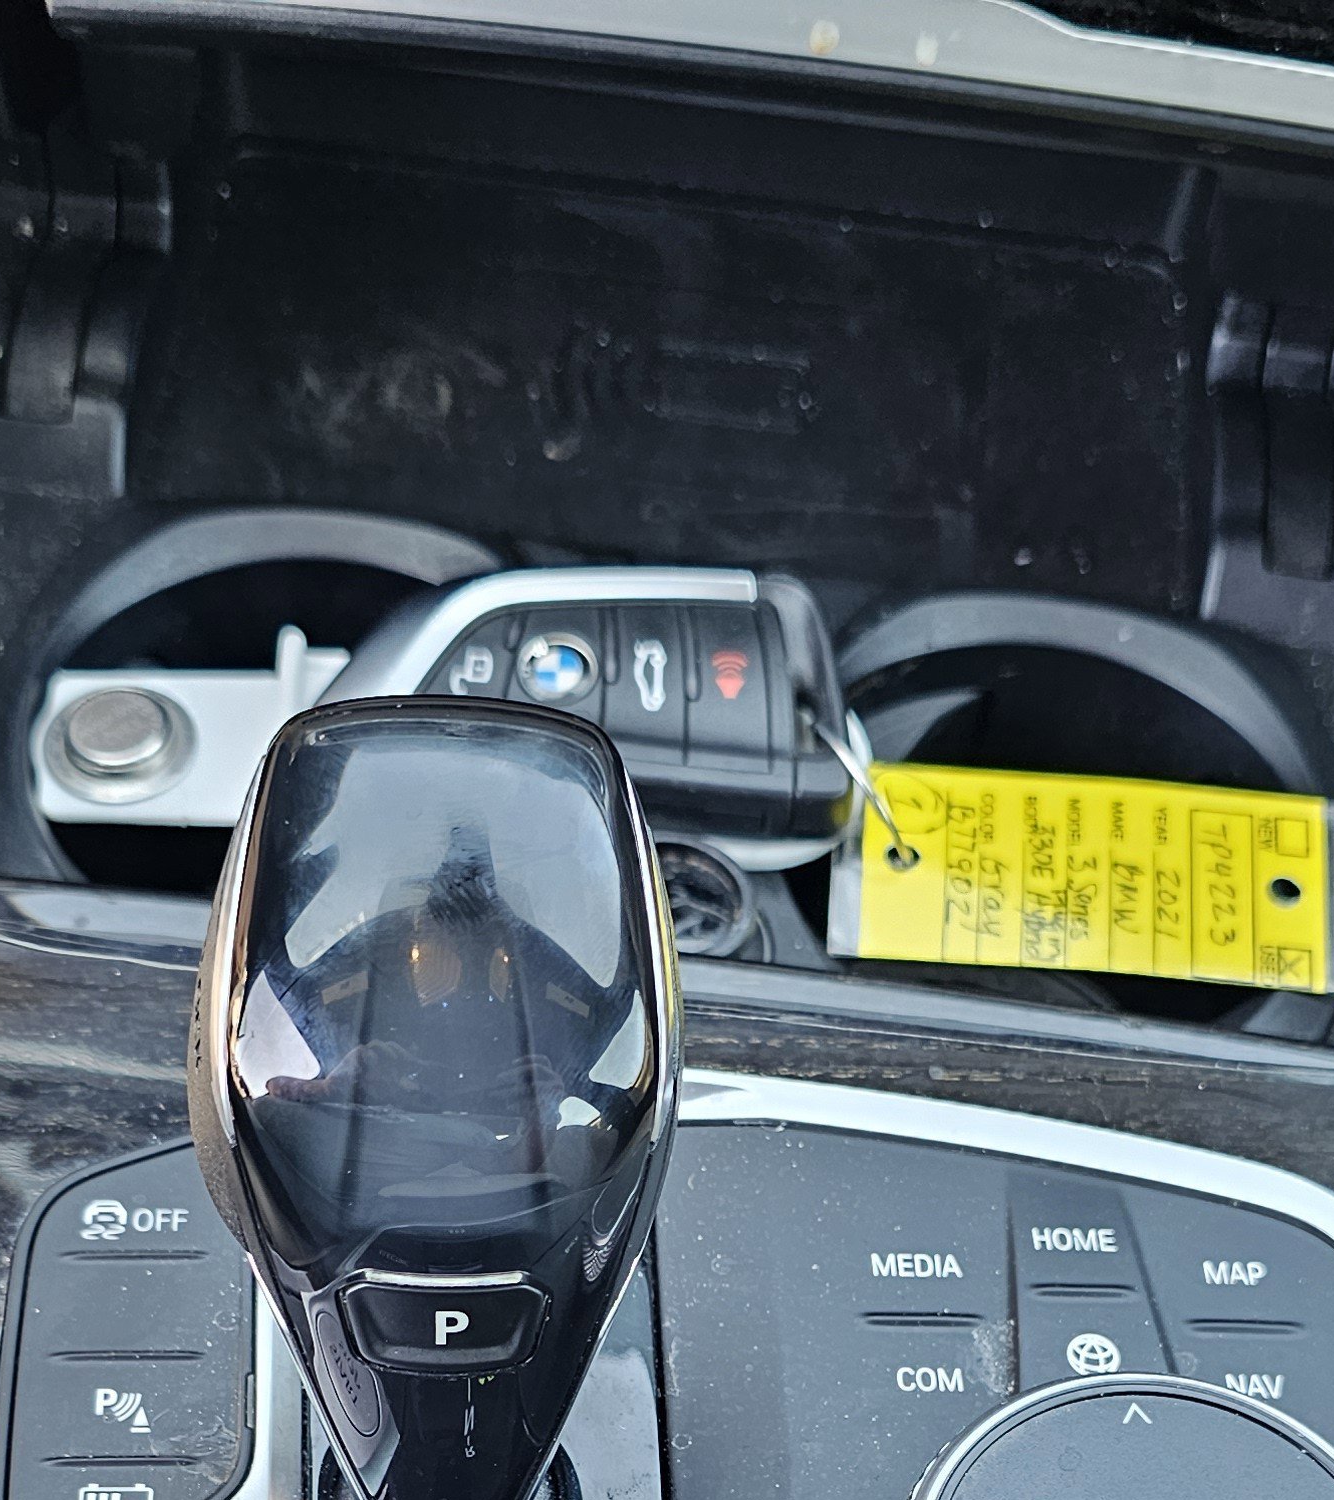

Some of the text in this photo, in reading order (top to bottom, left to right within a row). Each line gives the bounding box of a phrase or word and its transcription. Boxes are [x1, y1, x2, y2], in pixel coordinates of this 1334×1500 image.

[1111, 861, 1146, 935] BMW
[1154, 868, 1182, 941] 2021
[131, 1208, 189, 1233] OFF
[1031, 1227, 1119, 1253] HOME
[870, 1252, 964, 1279] MEDIA
[1202, 1260, 1268, 1287] MAP
[433, 1310, 470, 1346] P
[895, 1366, 965, 1394] COM
[1224, 1373, 1285, 1400] NAV
